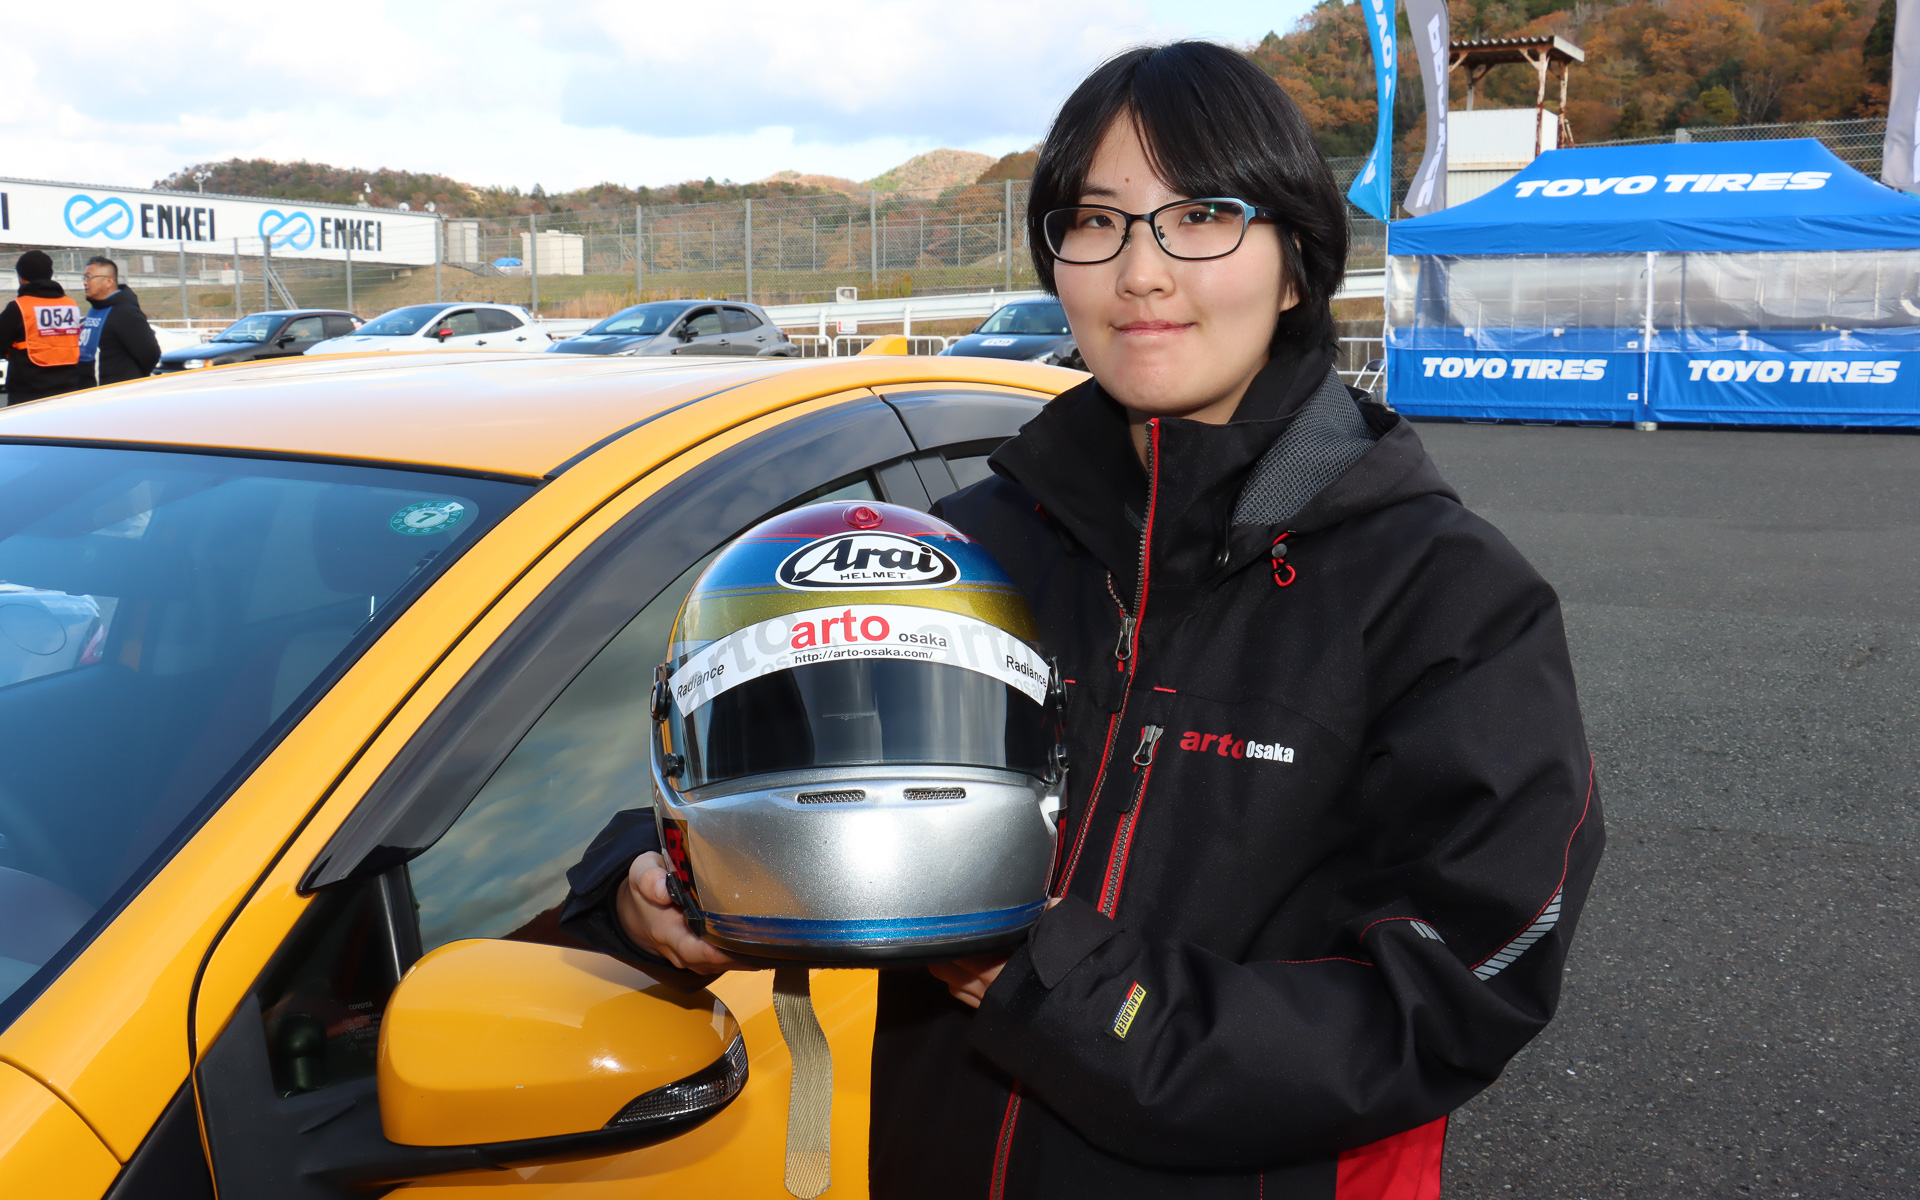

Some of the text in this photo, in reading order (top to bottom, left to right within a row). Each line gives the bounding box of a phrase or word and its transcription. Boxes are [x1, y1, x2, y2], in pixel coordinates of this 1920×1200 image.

[1515, 171, 1832, 198] TOYO TIRES
[140, 203, 215, 242] ENKEI
[320, 216, 382, 251] ENKEI
[40, 308, 74, 328] 054
[1422, 357, 1608, 381] TOYO TIRES
[1688, 359, 1901, 384] TOYO TIRES
[415, 512, 437, 523] 7
[791, 538, 939, 582] Arai
[840, 571, 908, 581] HELMET
[791, 608, 948, 649] arto osaka
[794, 647, 934, 664] http://arto-osaka.com/
[676, 663, 725, 701] Radiance
[1006, 654, 1047, 688] Radiance
[1179, 731, 1295, 764] arto Osaka
[348, 1001, 374, 1010] TOYOTA
